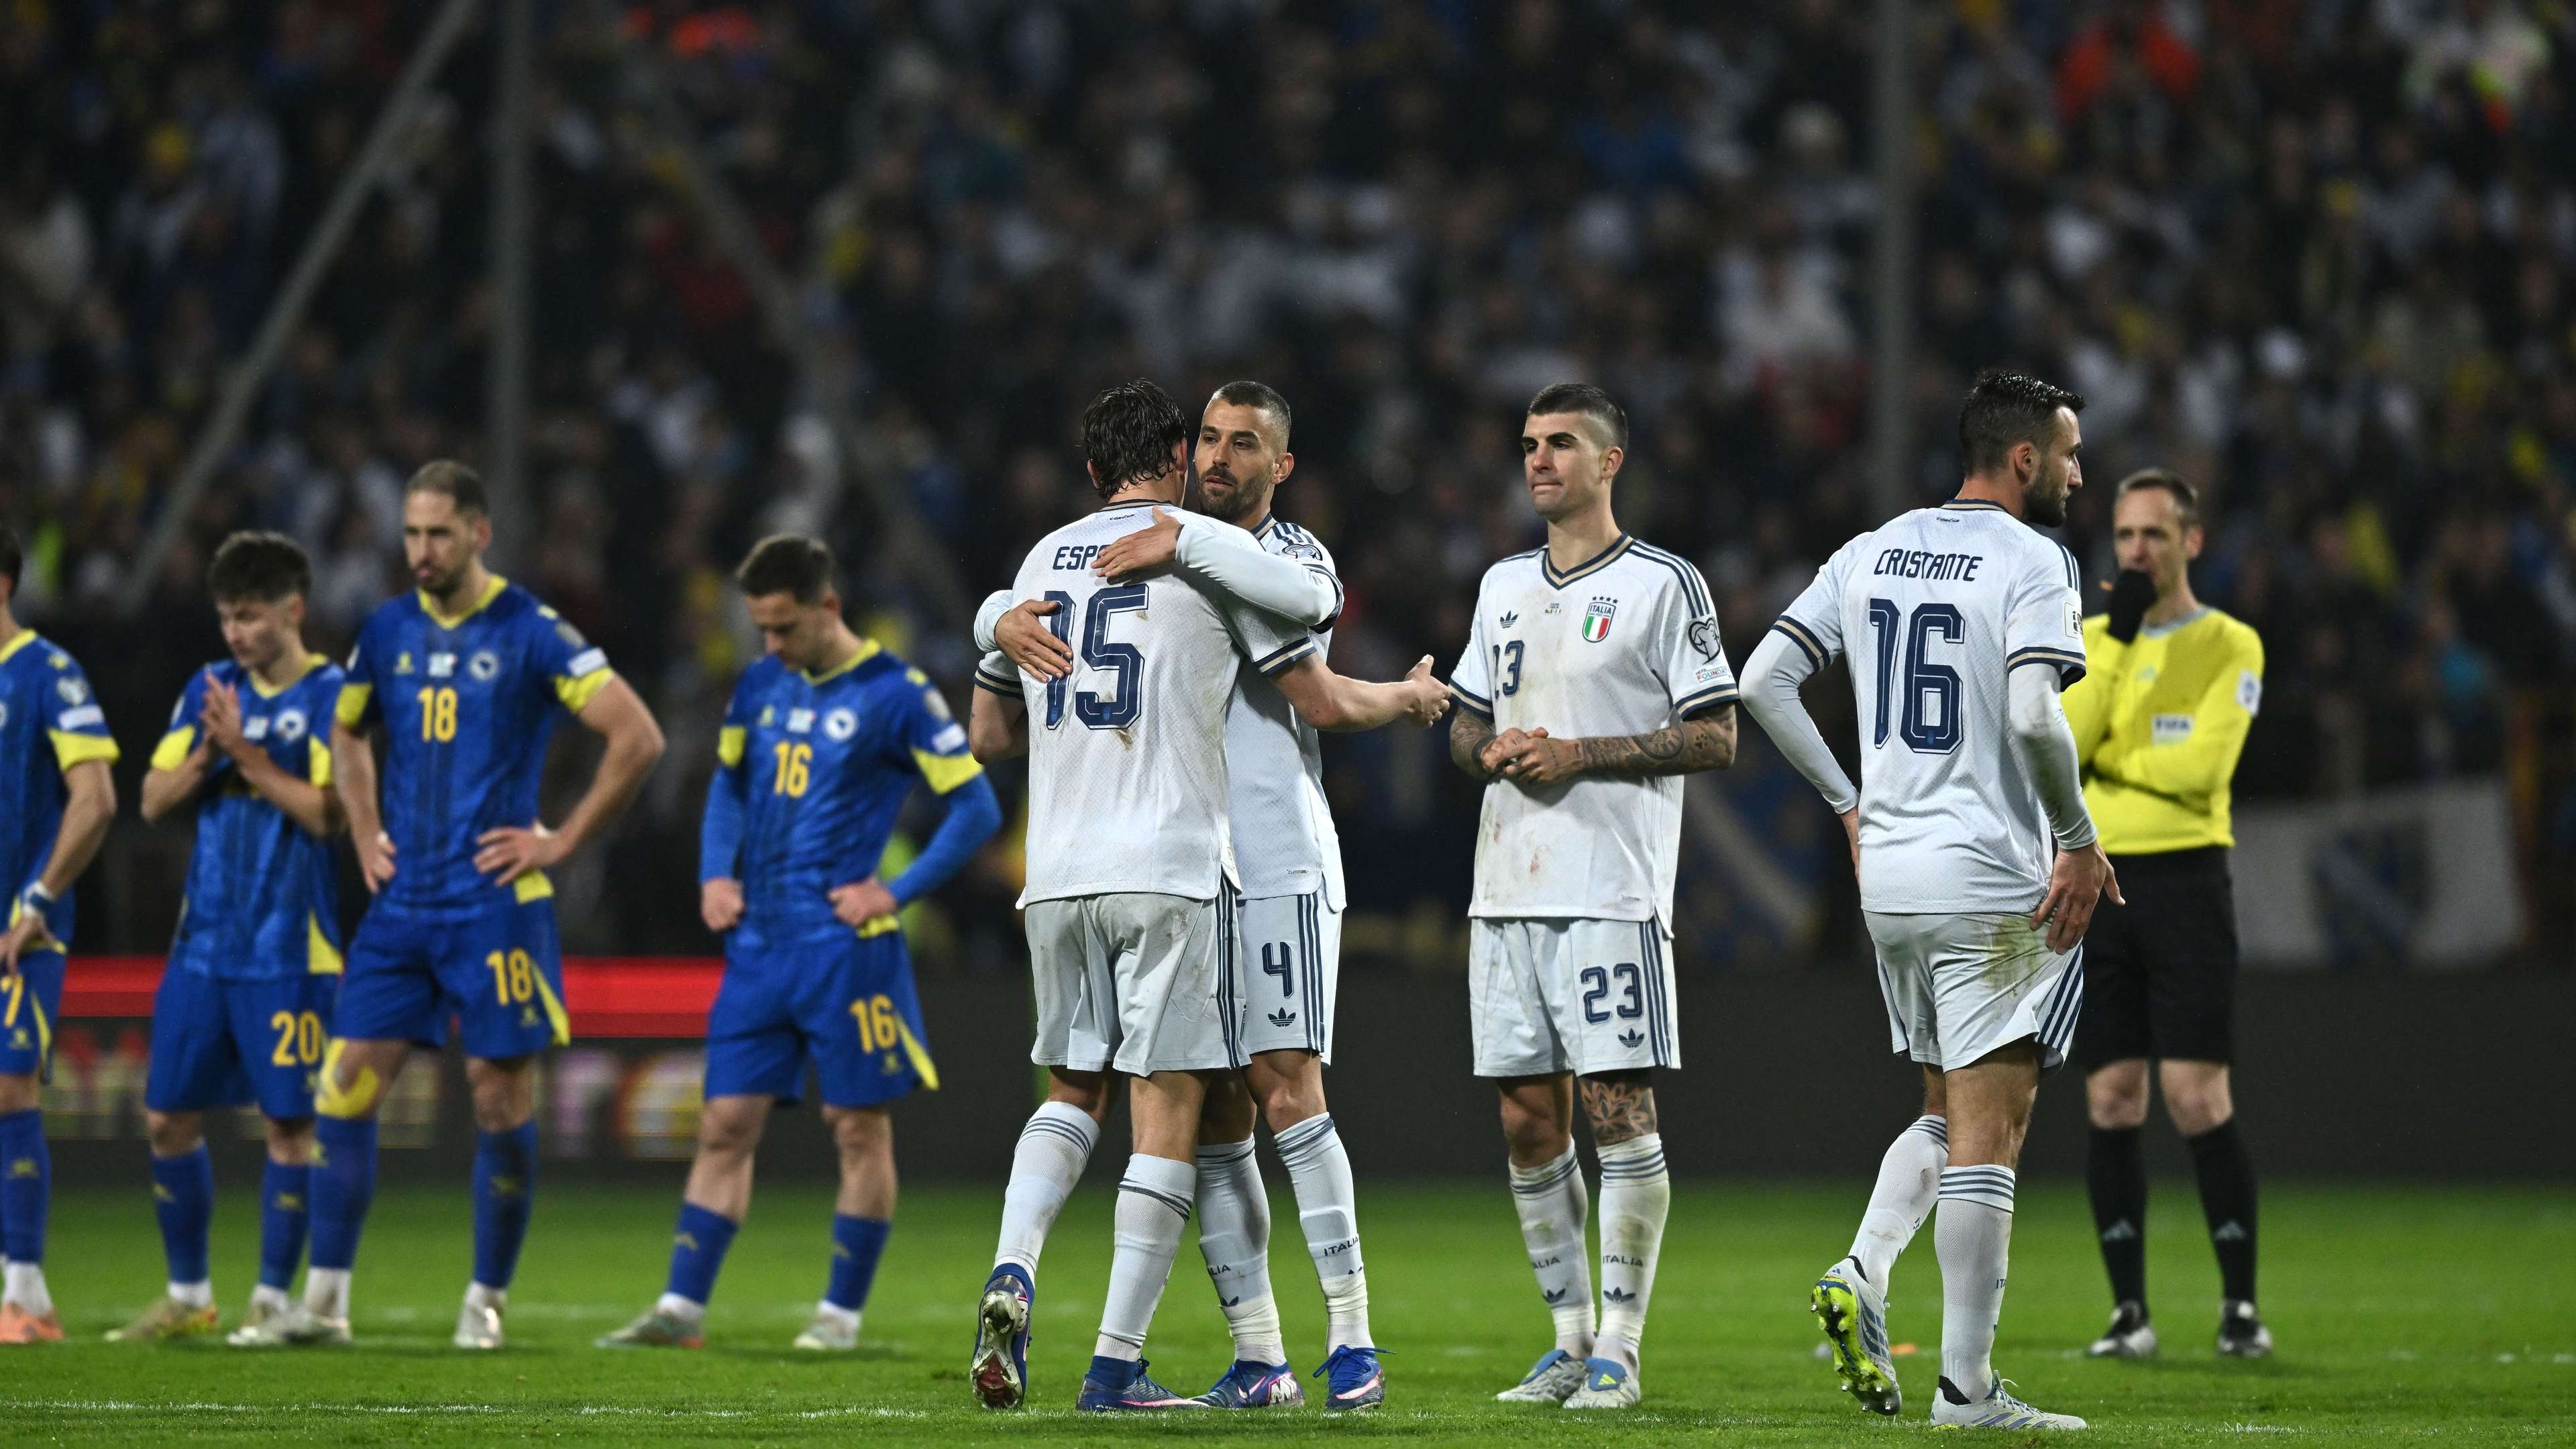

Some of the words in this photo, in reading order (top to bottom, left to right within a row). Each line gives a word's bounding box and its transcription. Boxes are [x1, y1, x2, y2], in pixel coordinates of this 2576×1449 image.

[1874, 549, 1983, 582] CRISTANTE
[1590, 604, 1611, 614] ITALIA
[1044, 584, 1149, 730] 15
[1870, 598, 1966, 755] 16
[418, 686, 458, 742] 18
[773, 741, 812, 798] 16
[486, 948, 533, 1006] 18
[1262, 942, 1294, 998] 4
[1580, 963, 1644, 1024] 23
[271, 1010, 319, 1067] 20
[849, 994, 896, 1053] 16
[1324, 1236, 1358, 1256] ITALIA
[1603, 1255, 1643, 1267] ITALIA
